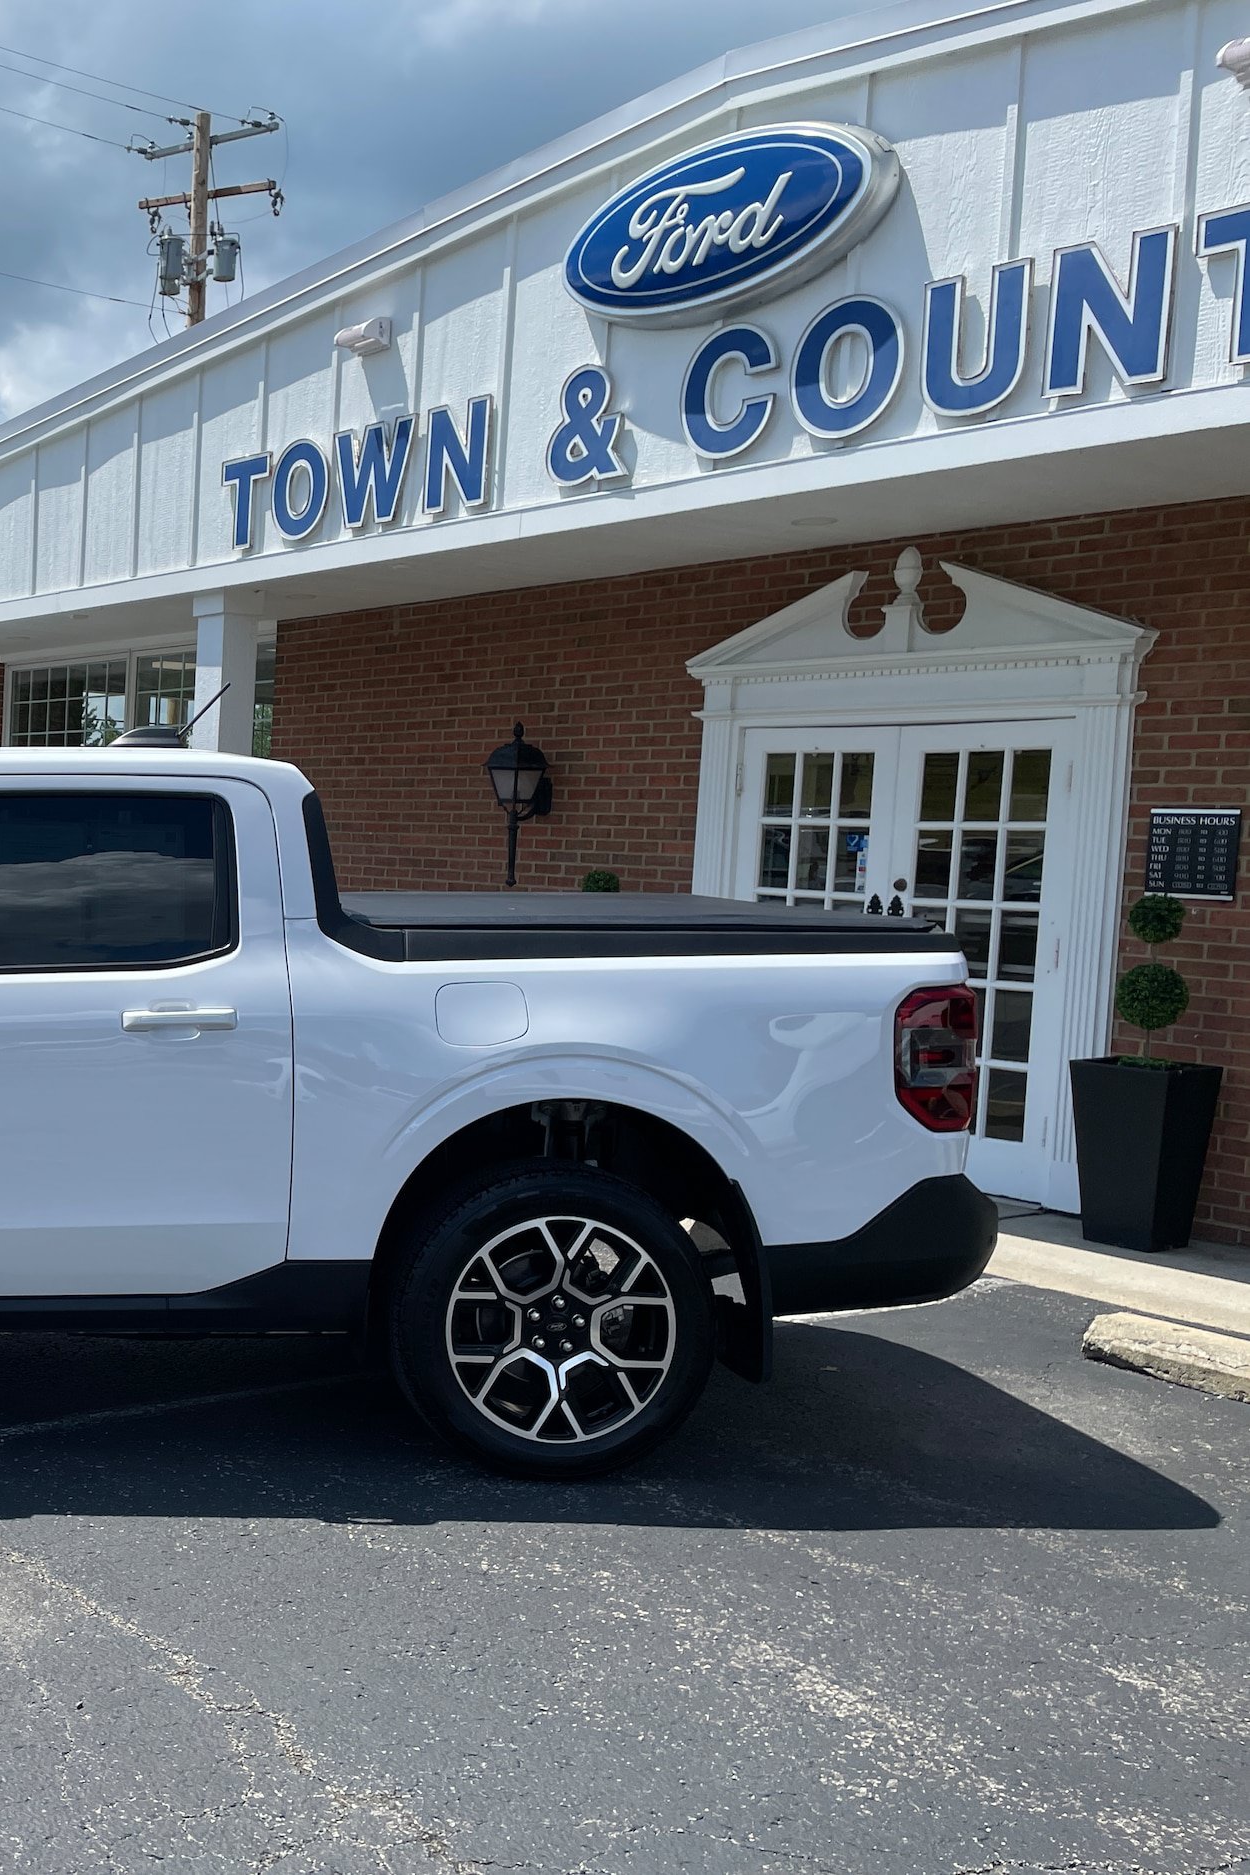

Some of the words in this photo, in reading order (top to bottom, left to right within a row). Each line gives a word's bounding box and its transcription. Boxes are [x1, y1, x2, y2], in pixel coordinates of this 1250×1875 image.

[611, 166, 793, 289] Ford
[221, 393, 492, 551] TOWN
[546, 364, 628, 487] &
[1153, 815, 1196, 825] BUSINESS
[1200, 816, 1236, 826] HOURS
[1152, 836, 1166, 844] TUE
[1151, 845, 1170, 853] WED
[1151, 853, 1167, 861] THU
[1149, 862, 1161, 870] FRI
[1148, 871, 1162, 879] SAT
[1148, 880, 1165, 888] SUN
